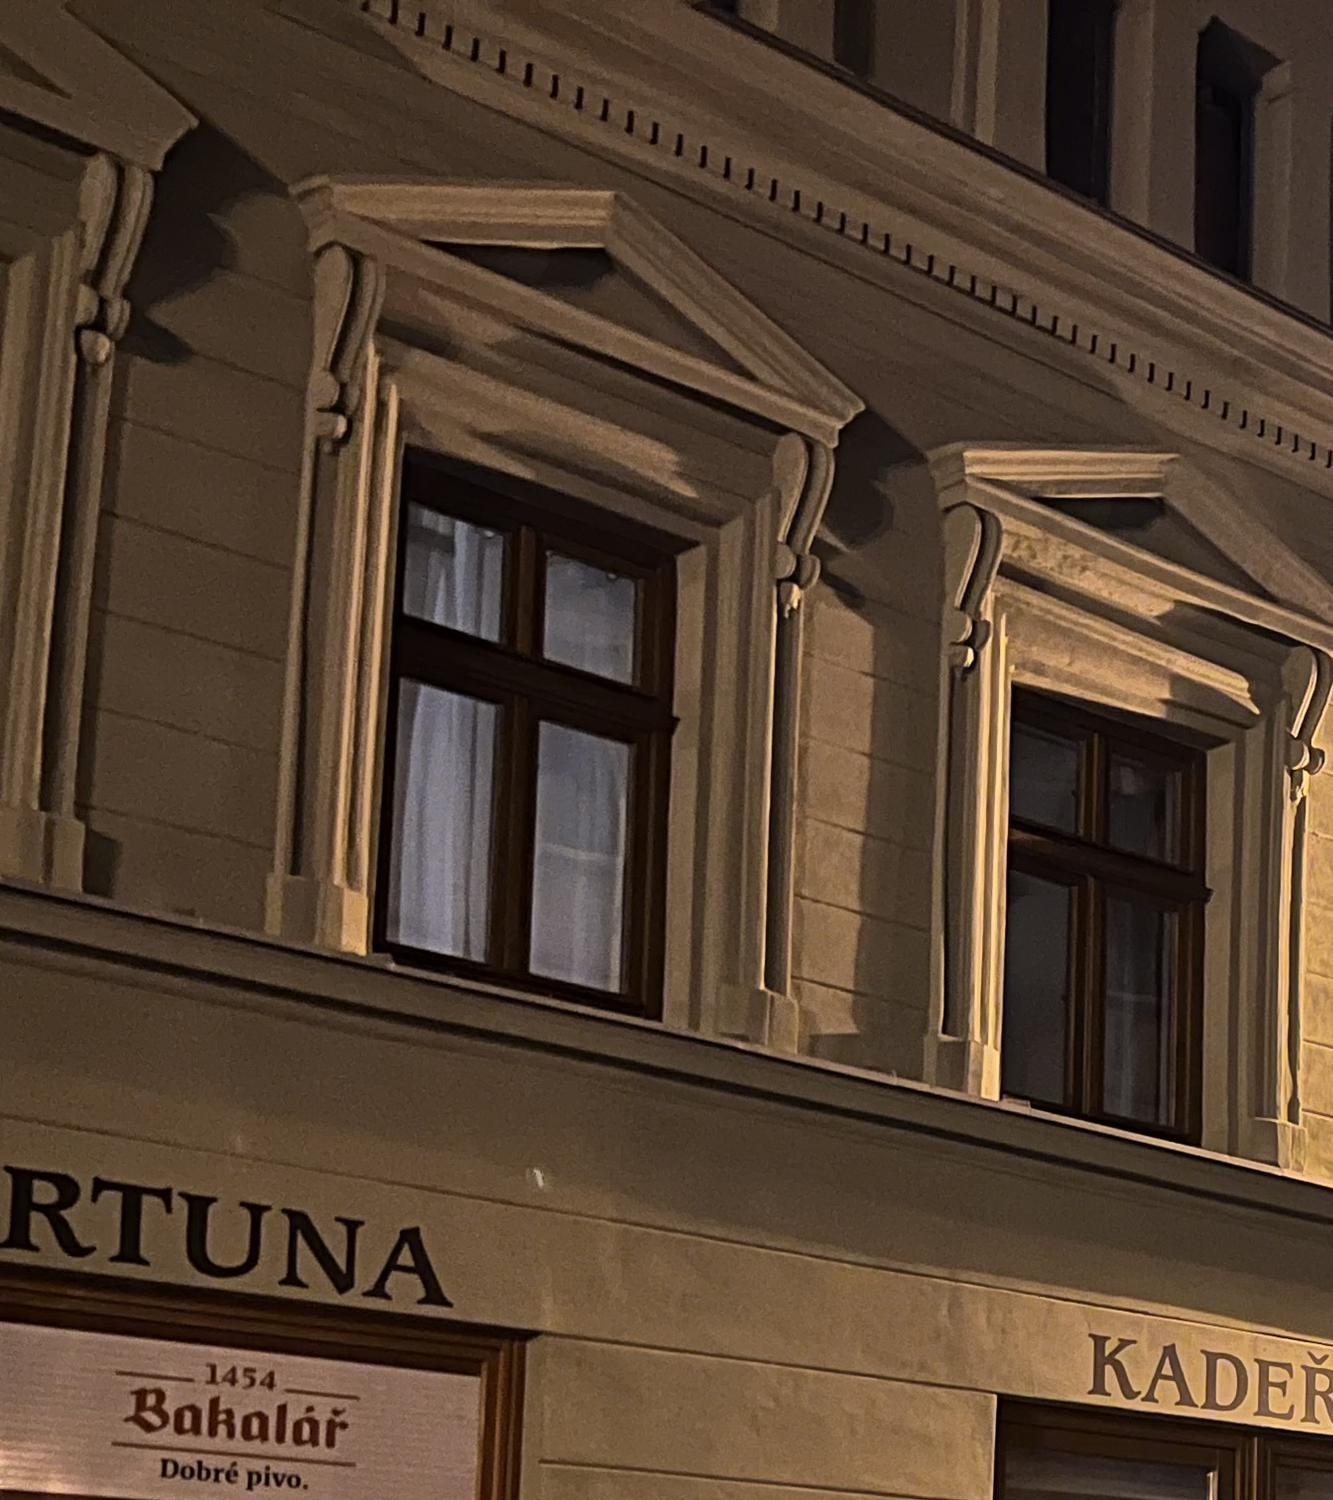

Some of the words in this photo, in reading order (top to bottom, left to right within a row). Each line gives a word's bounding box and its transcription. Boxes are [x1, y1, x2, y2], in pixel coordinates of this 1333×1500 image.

[0, 1165, 454, 1308] RTUNA
[204, 1363, 276, 1392] 1454
[123, 1386, 349, 1449] Bakalář
[160, 1458, 239, 1484] Dobré
[246, 1465, 309, 1491] pivo.
